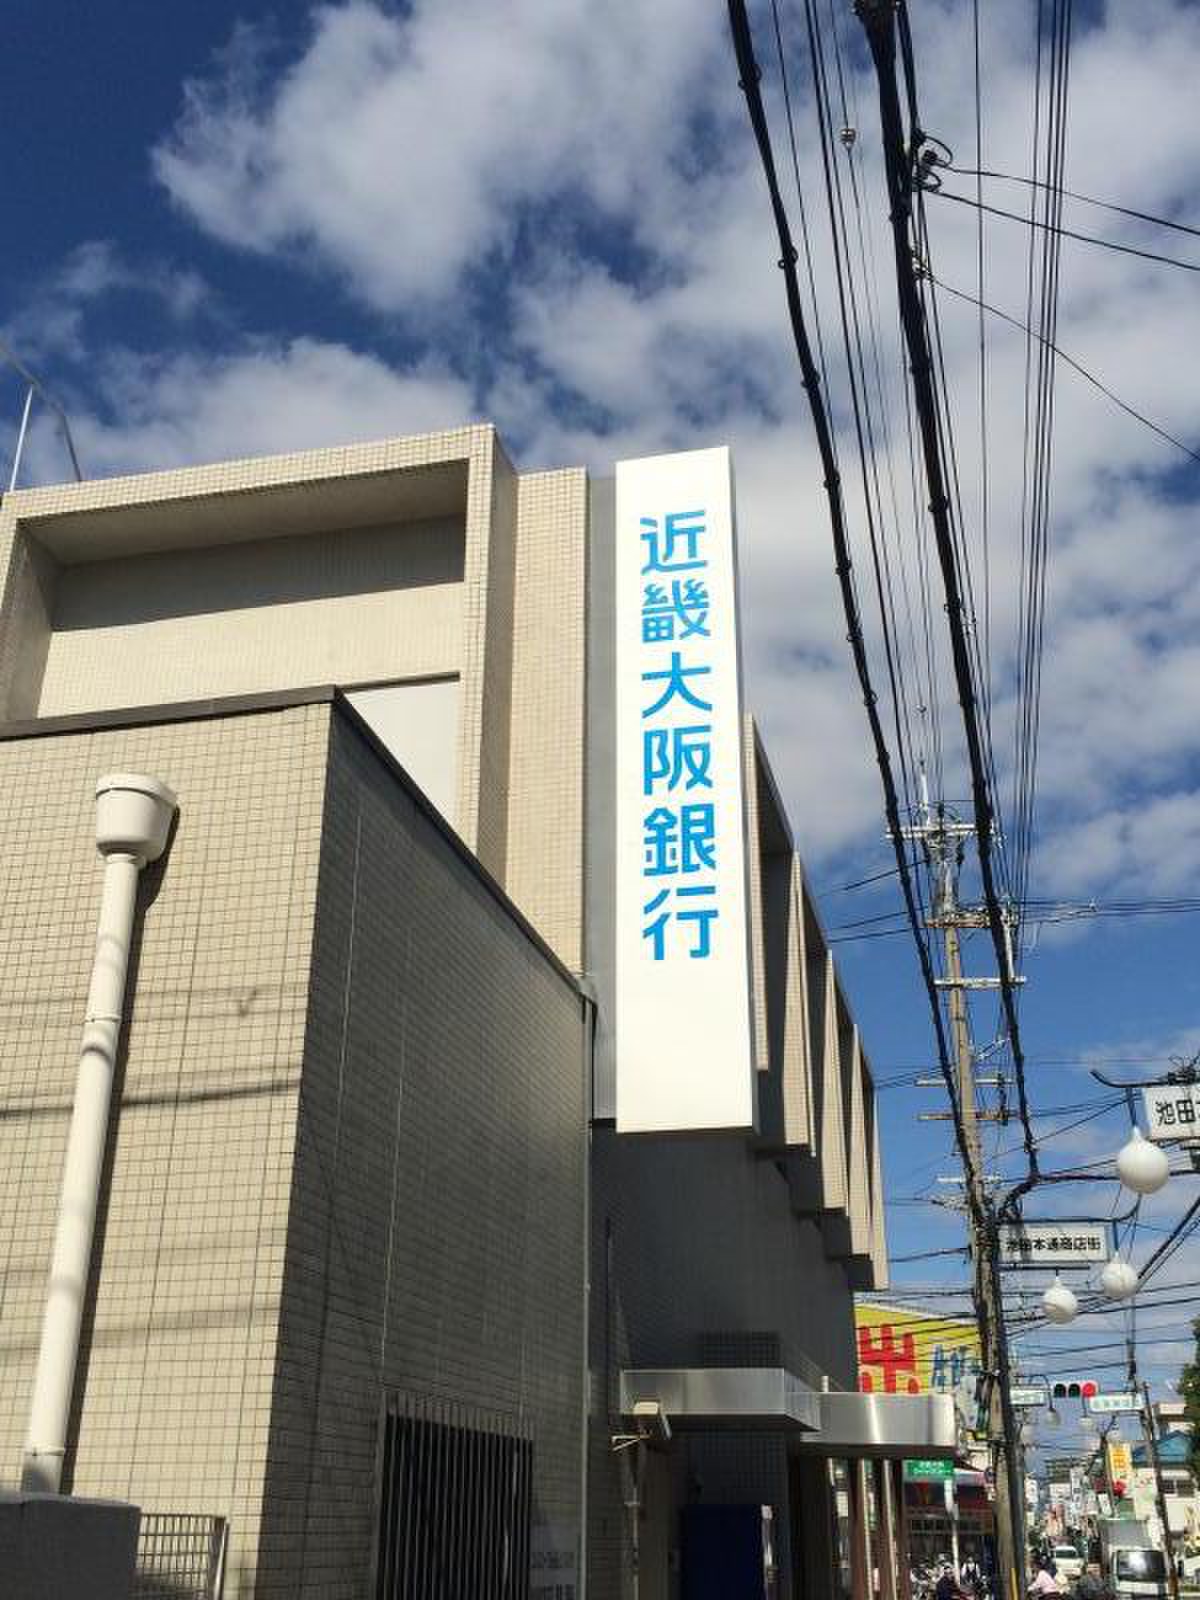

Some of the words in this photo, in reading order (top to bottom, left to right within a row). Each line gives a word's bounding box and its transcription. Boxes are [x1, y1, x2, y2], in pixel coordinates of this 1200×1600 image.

[640, 510, 719, 961] 近畿大阪銀行
[1155, 1099, 1200, 1127] 池田
